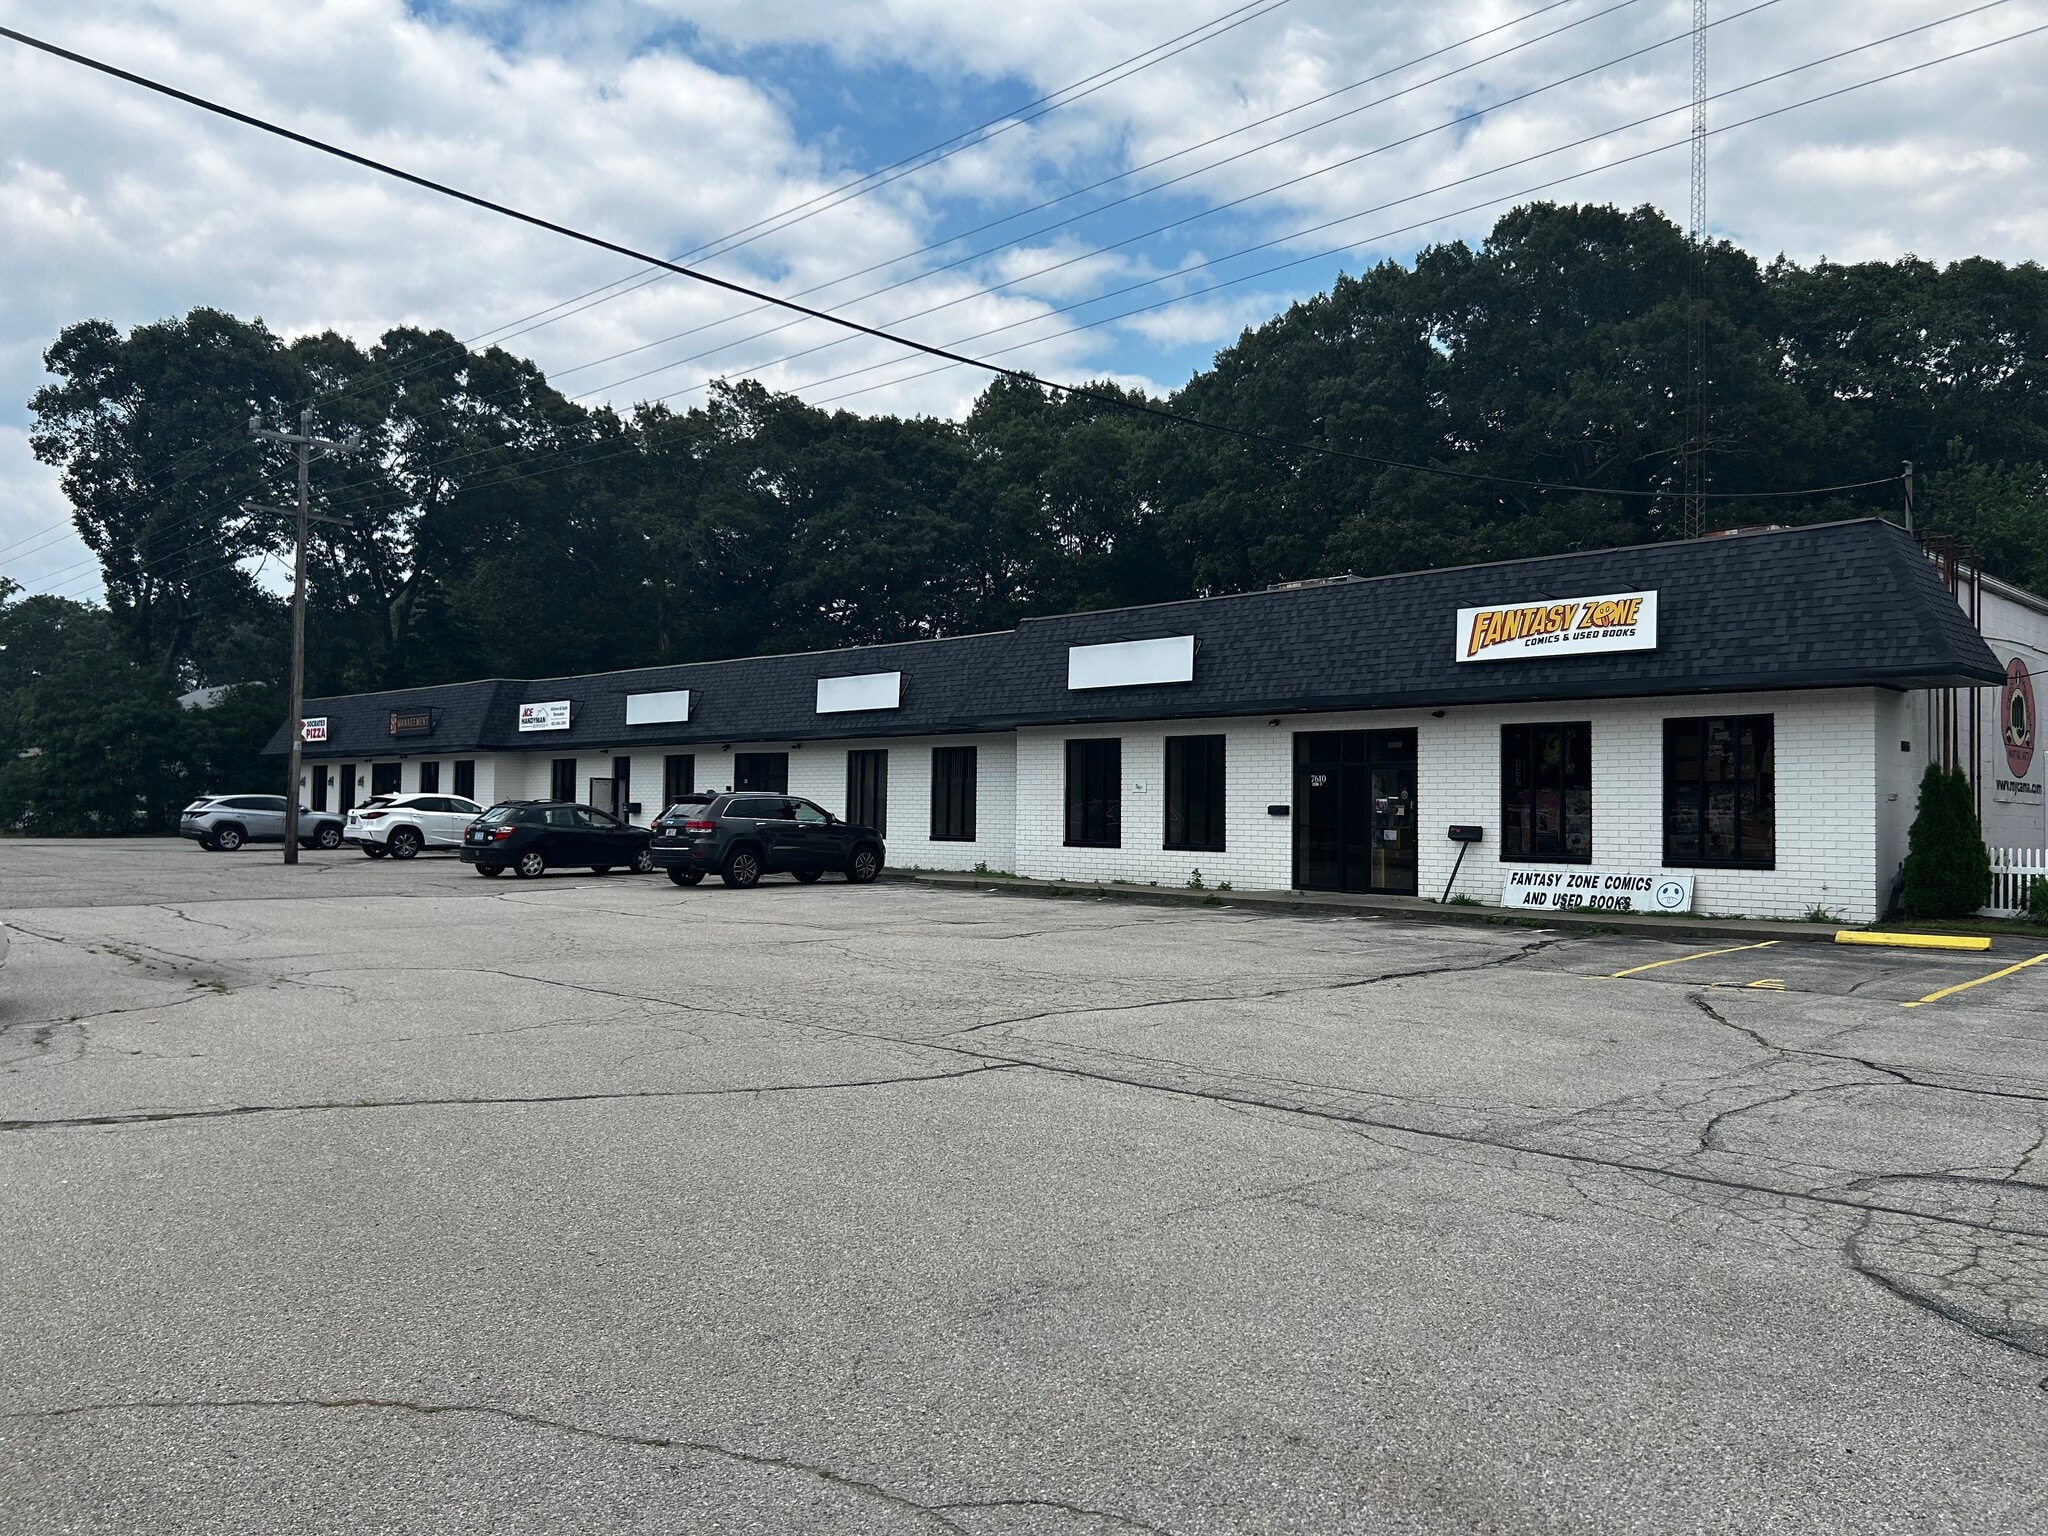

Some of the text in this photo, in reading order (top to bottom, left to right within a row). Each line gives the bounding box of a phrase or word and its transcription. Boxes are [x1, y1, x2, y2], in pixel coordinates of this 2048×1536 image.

[1467, 598, 1643, 657] FANTASY ZONE
[1524, 628, 1636, 647] COMICS & USED BOOKS
[306, 727, 326, 739] PIZZA
[1510, 872, 1652, 891] FANTASY ZONE COMICS
[1522, 892, 1547, 906] AND
[1552, 894, 1583, 907] USED
